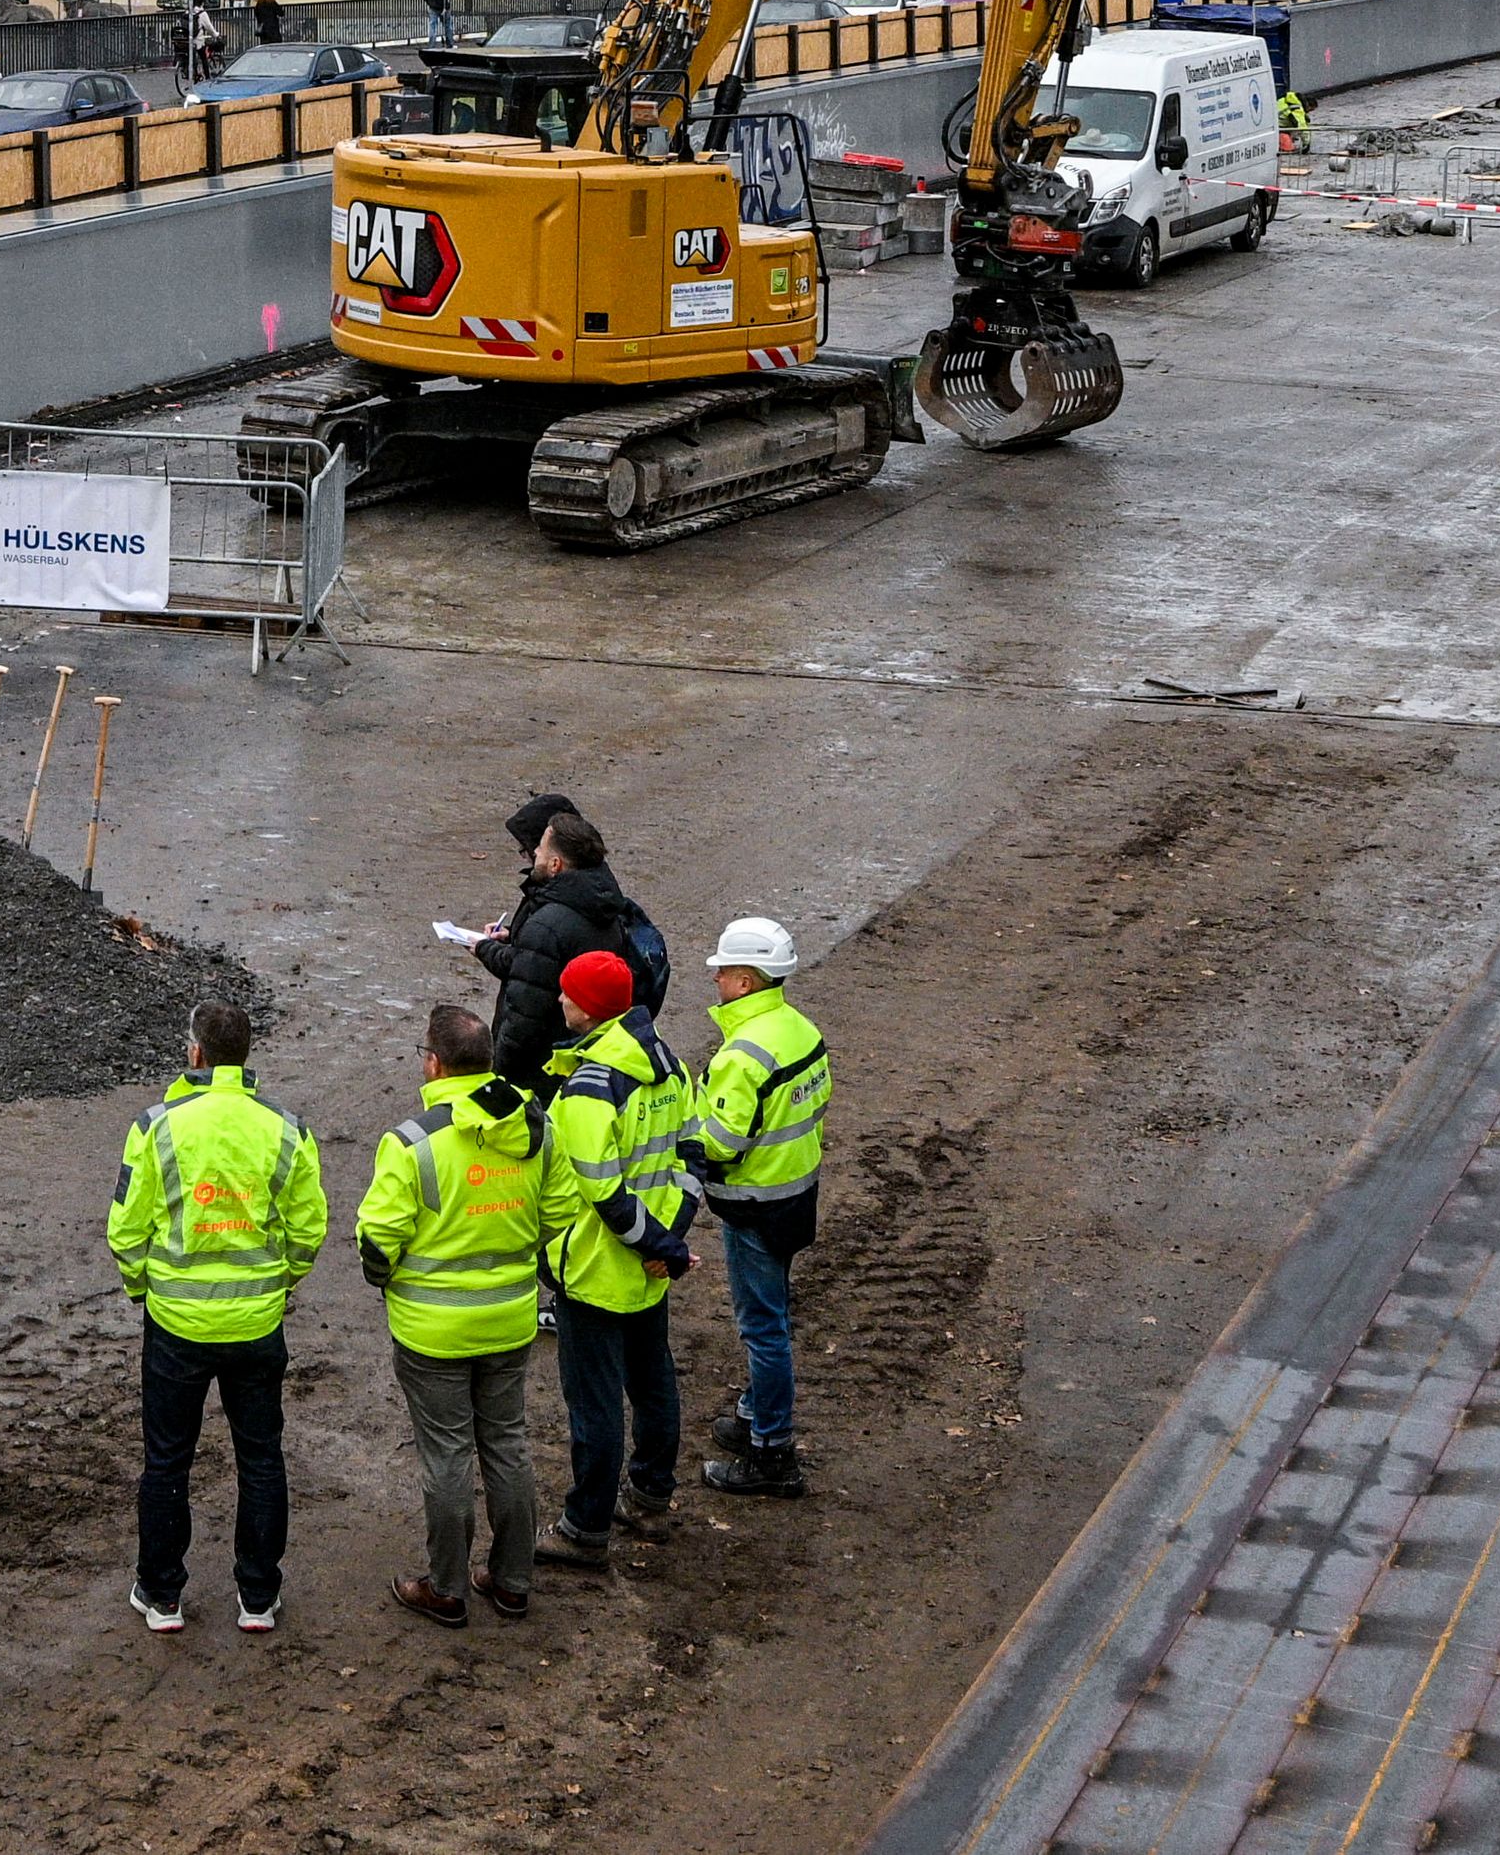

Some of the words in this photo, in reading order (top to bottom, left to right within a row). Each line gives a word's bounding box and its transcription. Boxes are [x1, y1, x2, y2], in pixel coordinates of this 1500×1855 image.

[348, 201, 425, 289] CAT
[675, 229, 717, 265] CAT
[4, 525, 146, 555] HÜLSKENS
[3, 554, 69, 566] WASSERBAU
[467, 1197, 525, 1217] ZEPPELIN
[194, 1219, 253, 1234] ZEPPELIN
